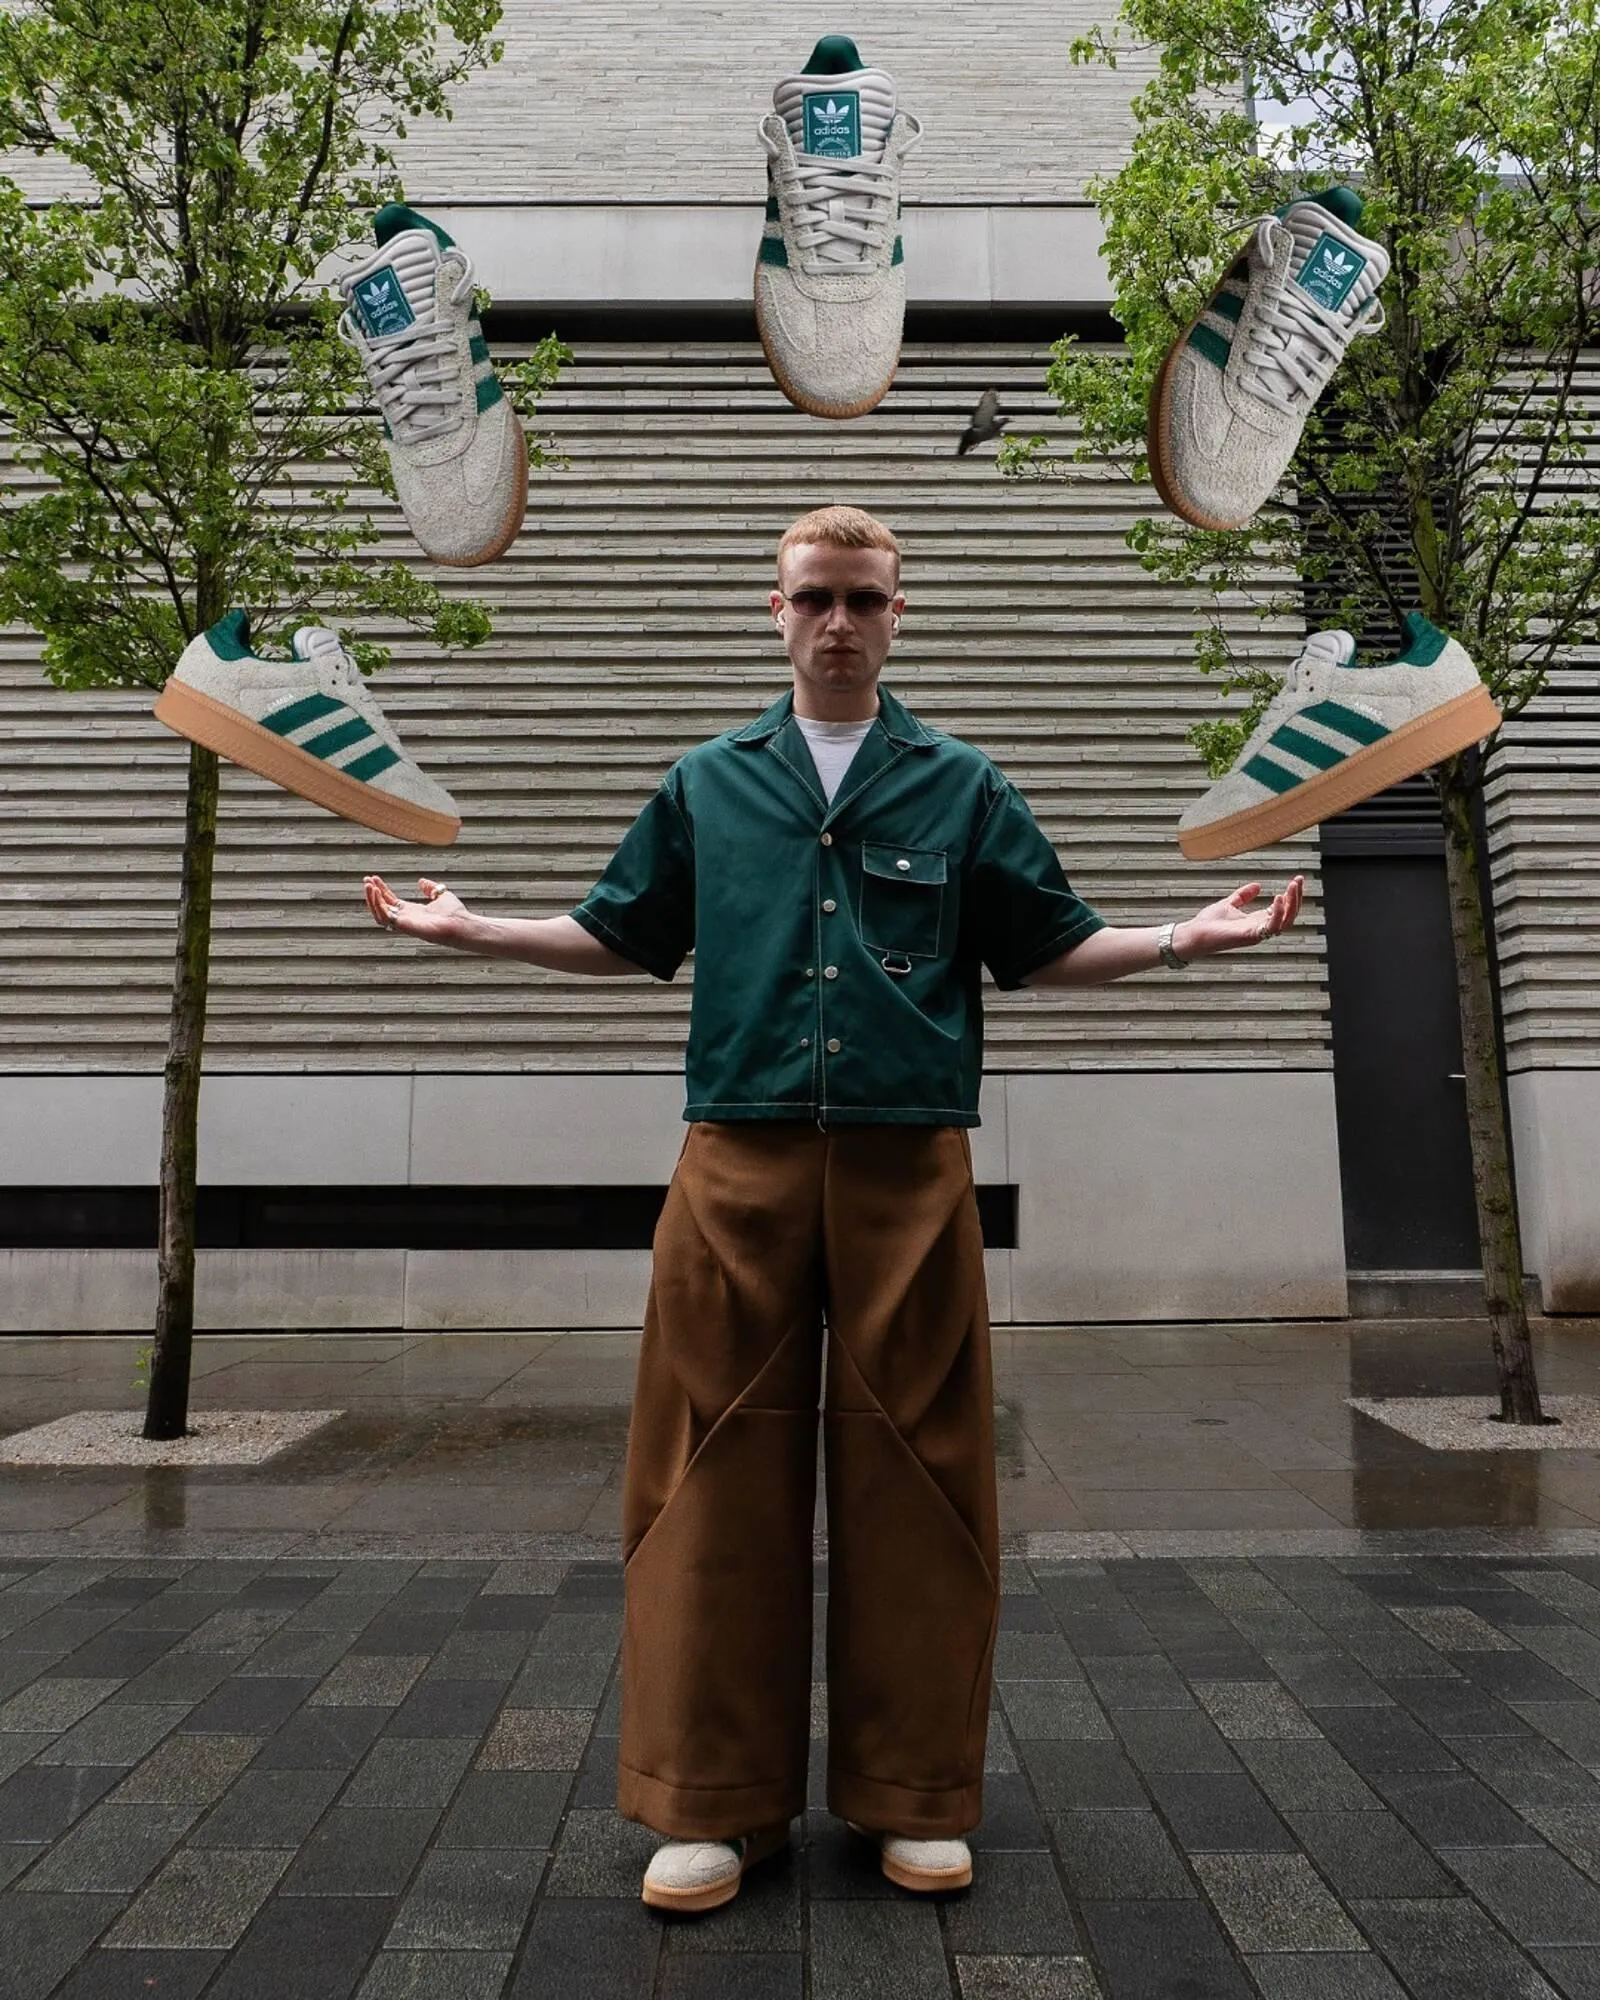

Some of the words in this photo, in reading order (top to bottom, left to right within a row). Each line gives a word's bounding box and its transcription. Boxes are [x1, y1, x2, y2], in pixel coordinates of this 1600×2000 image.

[814, 125, 850, 136] adidas
[1313, 267, 1343, 290] adidas
[371, 300, 399, 319] adidas
